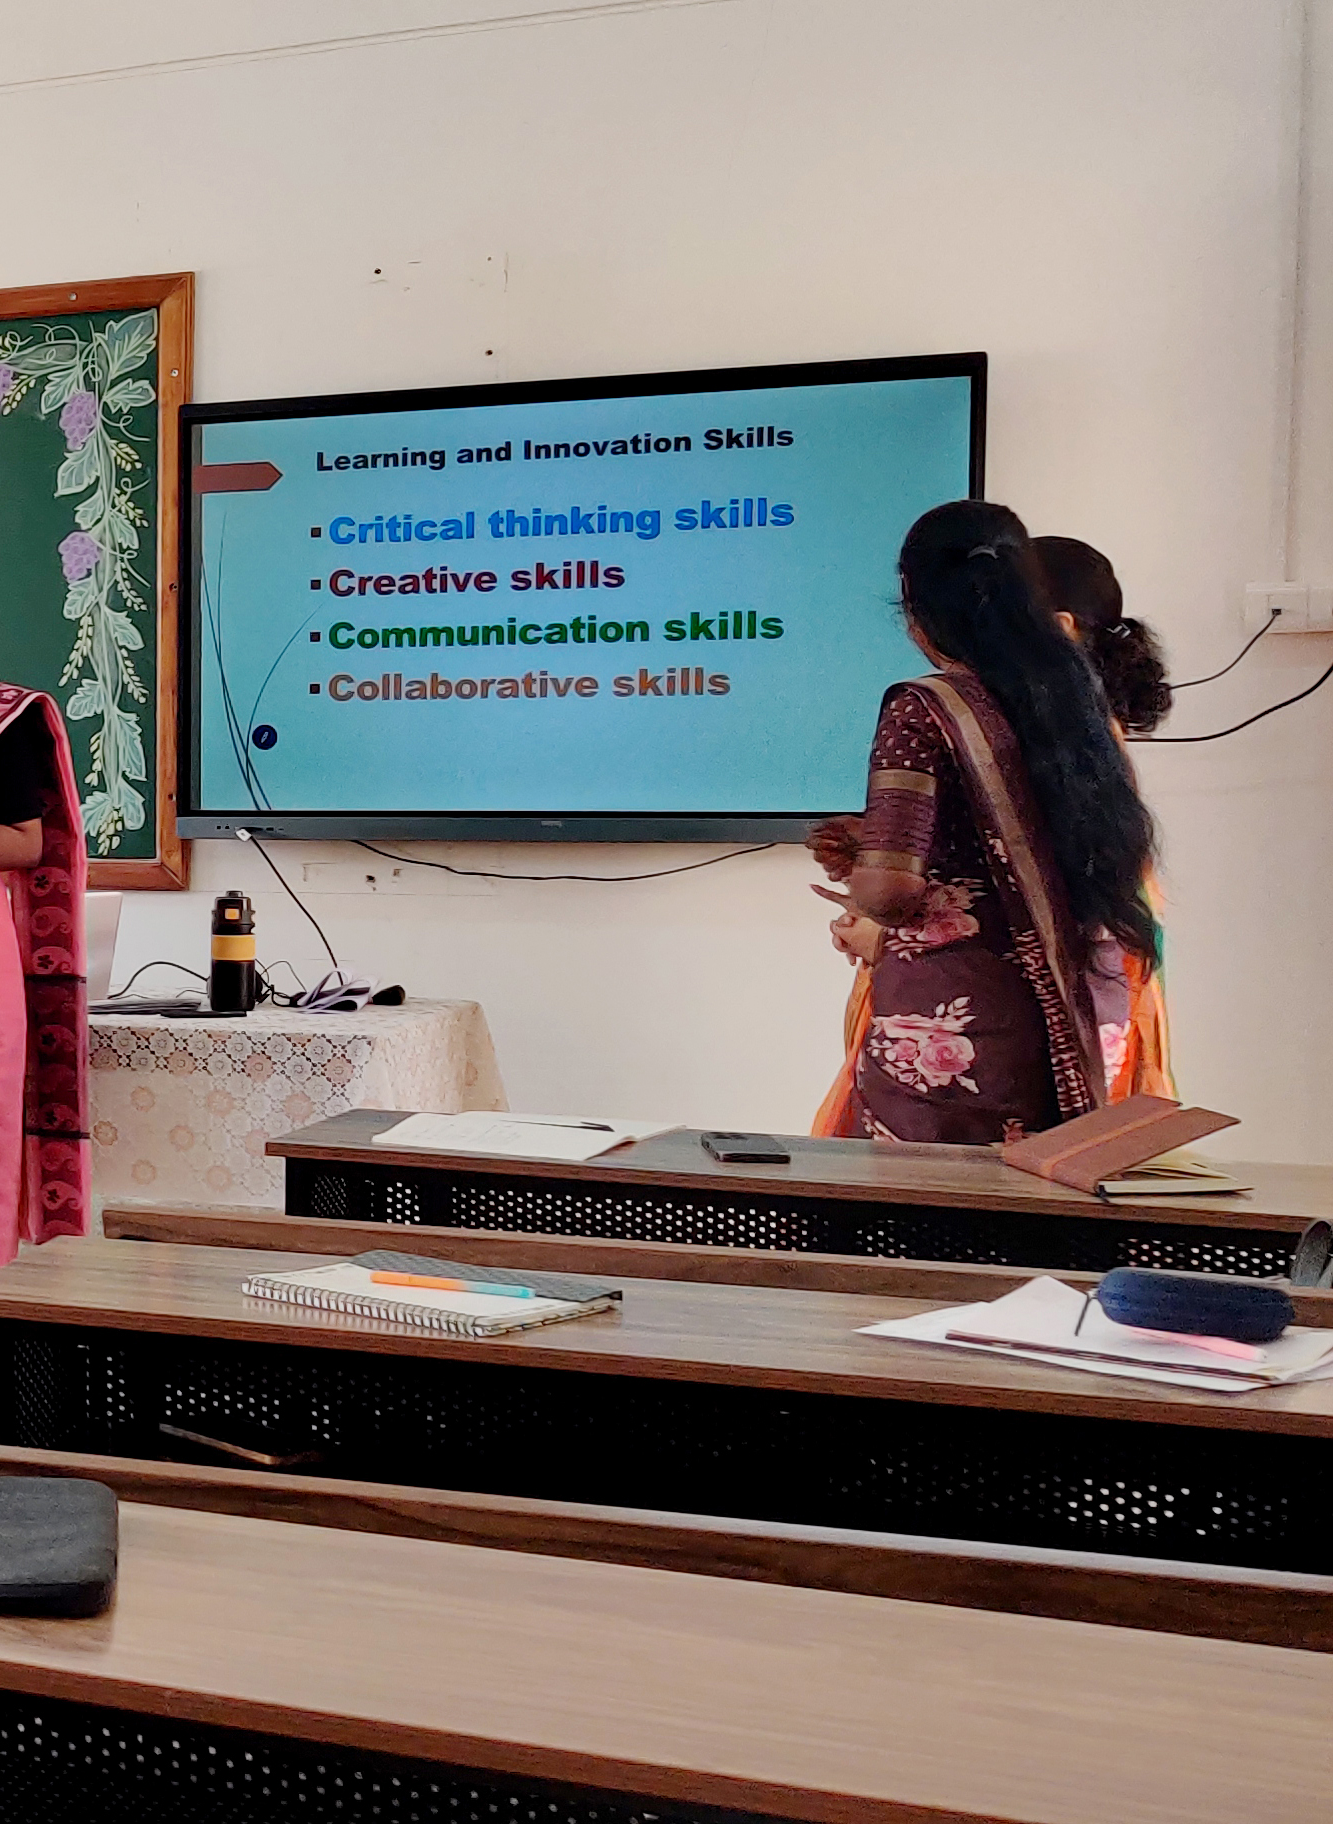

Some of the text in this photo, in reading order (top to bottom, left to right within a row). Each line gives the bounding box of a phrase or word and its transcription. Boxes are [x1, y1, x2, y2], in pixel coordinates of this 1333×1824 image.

[316, 426, 794, 471] Learning and Innovation Skills
[329, 497, 795, 545] Critical thinking skills
[329, 560, 625, 597] Creative skills
[329, 610, 785, 649] Communication skills
[328, 667, 731, 701] Collaborative skills
